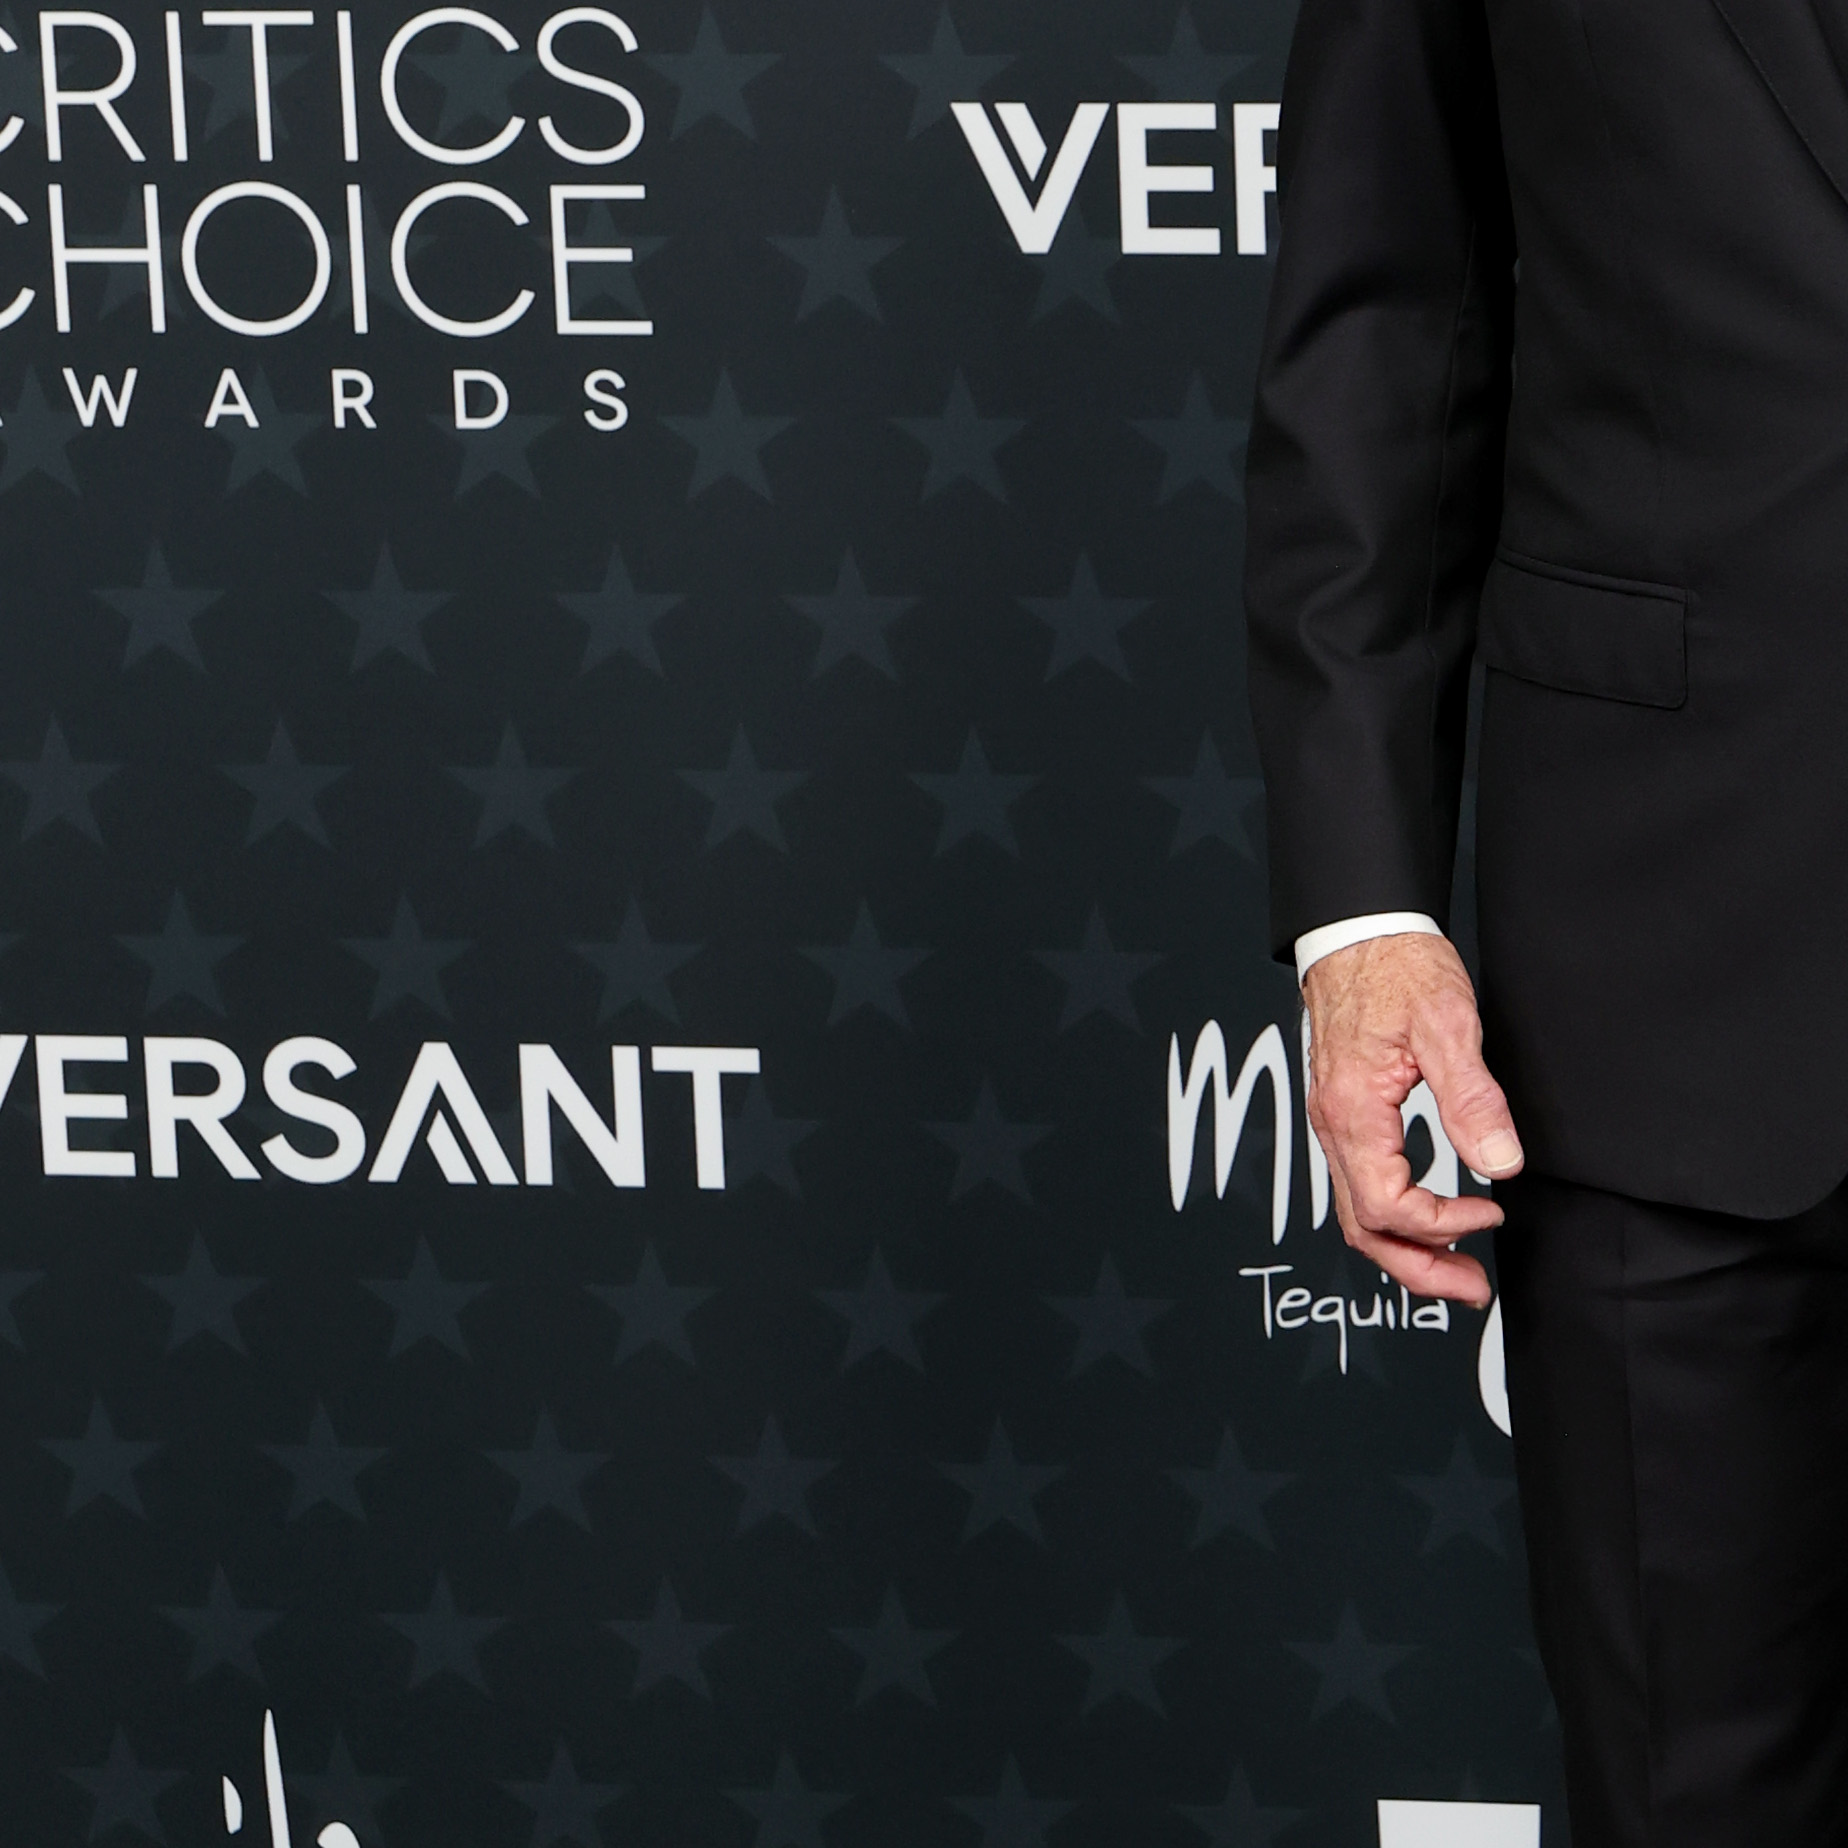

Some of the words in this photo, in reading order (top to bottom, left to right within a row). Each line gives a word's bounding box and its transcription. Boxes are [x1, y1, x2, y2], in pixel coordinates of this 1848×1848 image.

[0, 7, 645, 165] RITICS
[0, 181, 653, 337] HOICE
[0, 367, 628, 431] WARDS
[0, 1034, 760, 1190] ERSANT
